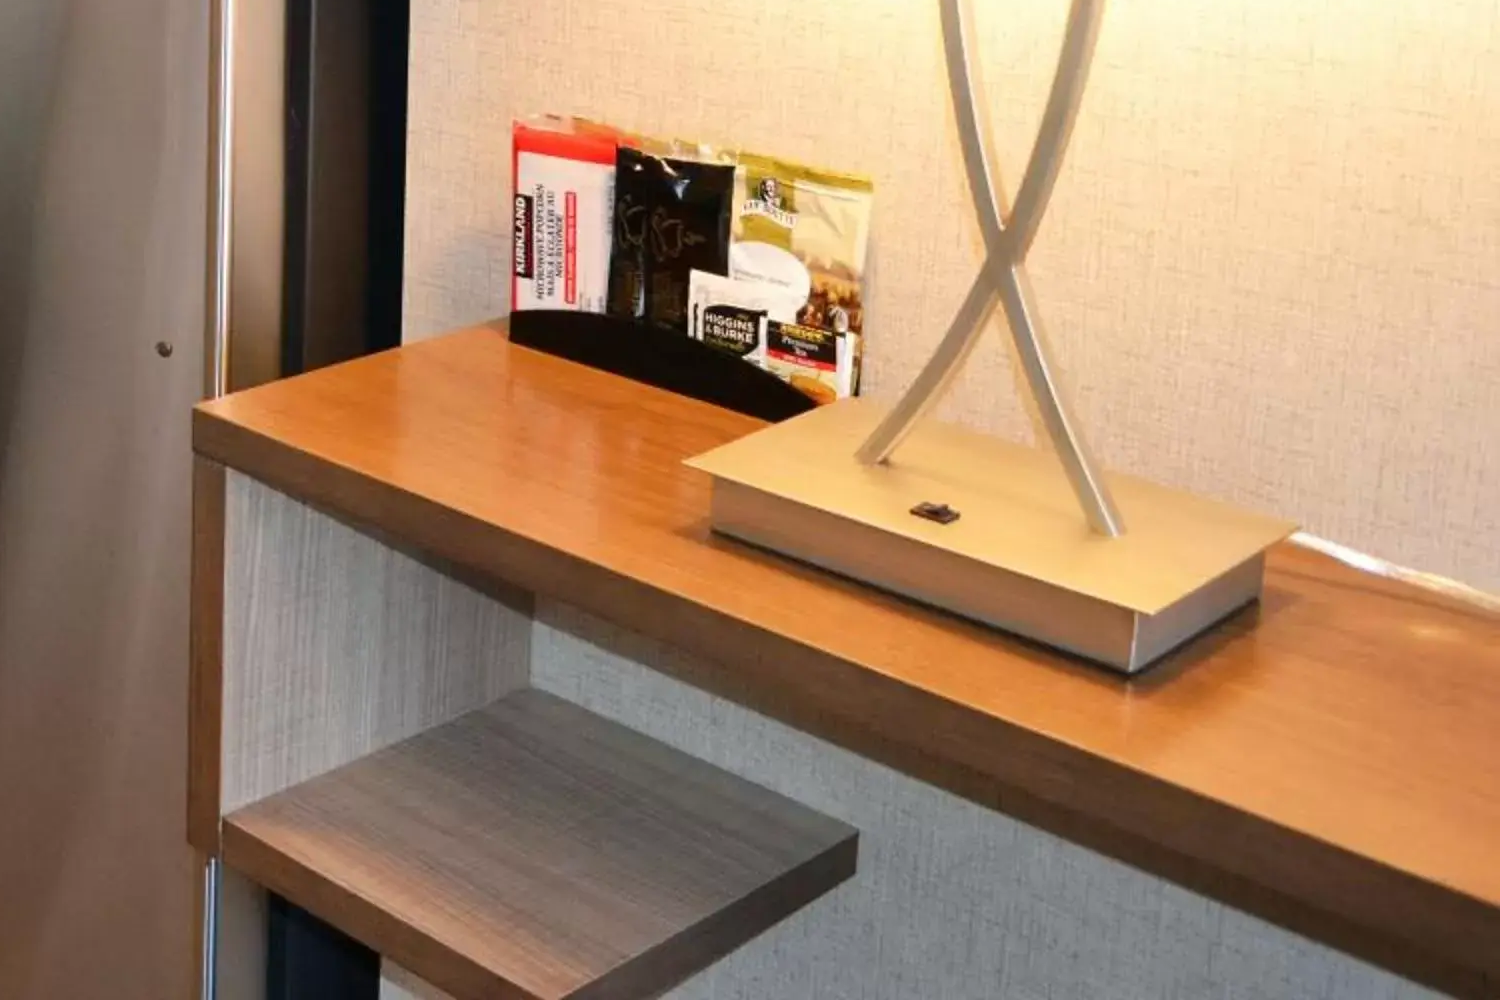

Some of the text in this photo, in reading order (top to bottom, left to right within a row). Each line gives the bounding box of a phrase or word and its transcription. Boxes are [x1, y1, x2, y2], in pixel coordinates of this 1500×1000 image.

[515, 196, 526, 274] KIRKLAND
[705, 312, 755, 332] HIGGINS
[713, 325, 754, 344] BURKE
